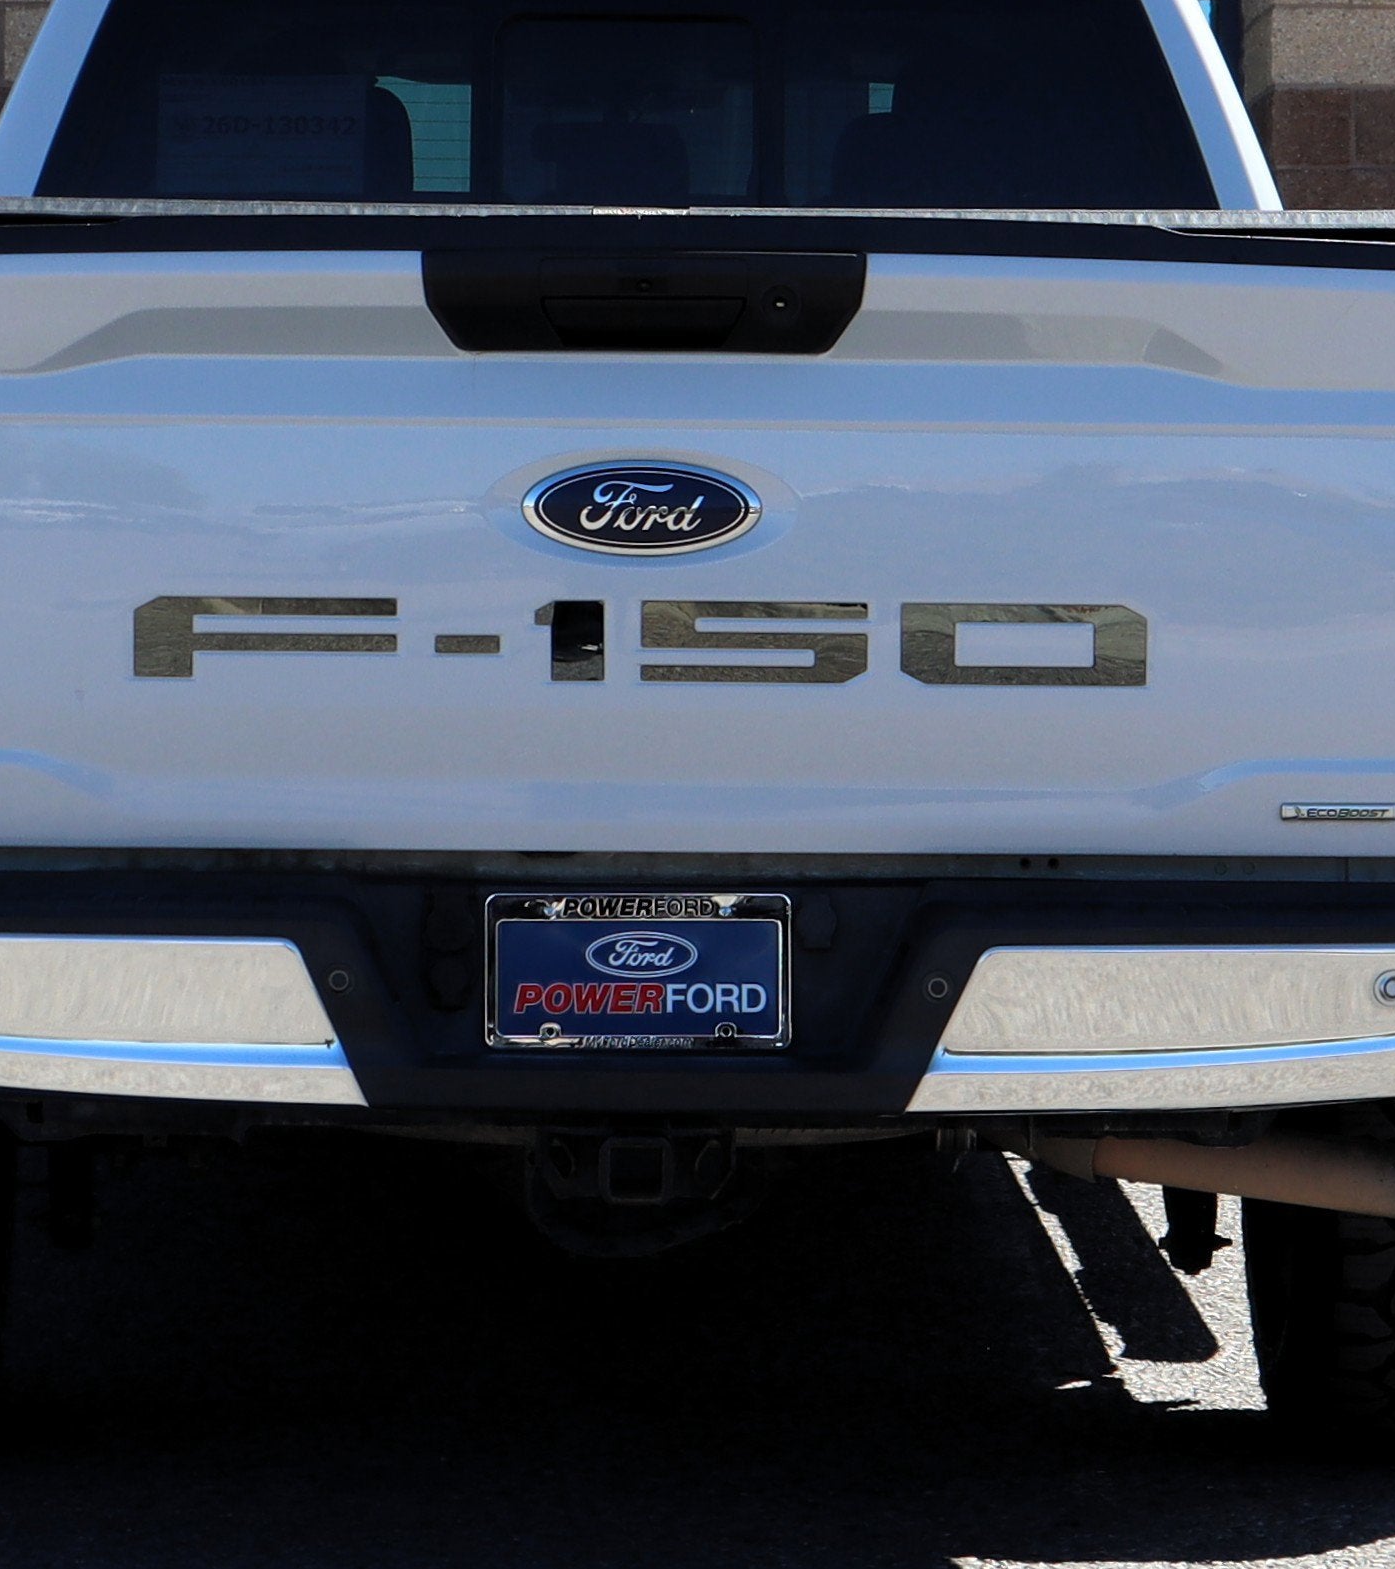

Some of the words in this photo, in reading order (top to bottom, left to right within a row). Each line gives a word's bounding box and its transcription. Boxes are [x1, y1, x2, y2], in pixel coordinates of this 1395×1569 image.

[579, 479, 705, 534] Ford
[132, 596, 1148, 686] F-150
[608, 940, 674, 966] Ford
[514, 983, 767, 1013] POWERFORD
